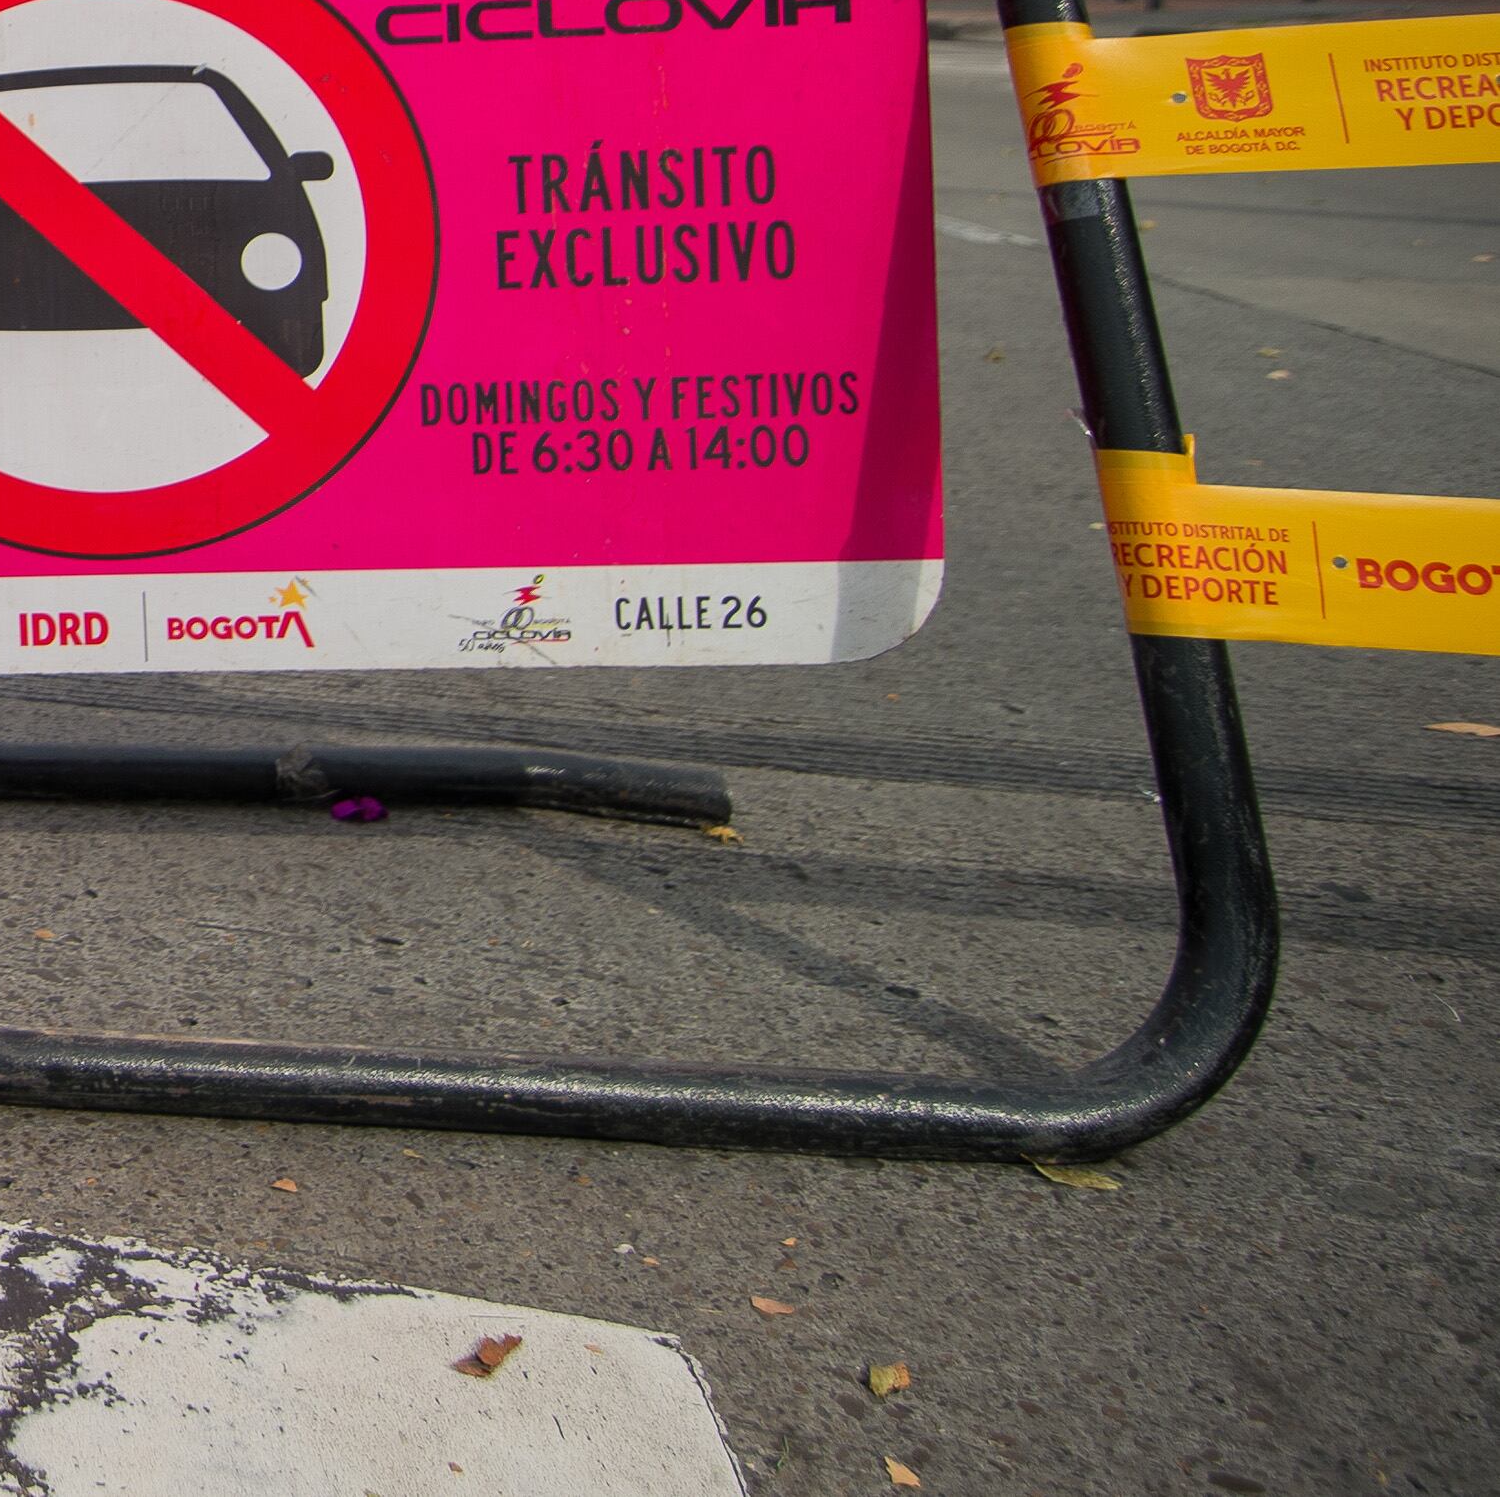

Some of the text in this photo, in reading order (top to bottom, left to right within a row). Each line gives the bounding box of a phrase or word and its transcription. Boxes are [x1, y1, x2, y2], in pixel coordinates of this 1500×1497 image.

[1364, 55, 1457, 72] INSTITUTO
[1375, 73, 1500, 102] RECREA
[1177, 125, 1305, 142] ALCALDÍA MAYOR
[1395, 107, 1414, 131] Y
[1186, 140, 1300, 155] DE BOGOTÁ D.C.
[508, 139, 776, 214] TRÁNSITO
[496, 221, 796, 290] EXCLUSIVO
[421, 371, 859, 427] DOMINGOS Y FESTIVOS
[472, 424, 810, 475] DE 6:30 A 14:00
[1183, 523, 1264, 542] DISTRITAL
[1269, 528, 1290, 542] DE
[1141, 574, 1280, 606] DEPORTE
[615, 595, 768, 631] CALLE 26
[19, 612, 109, 647] IDRD
